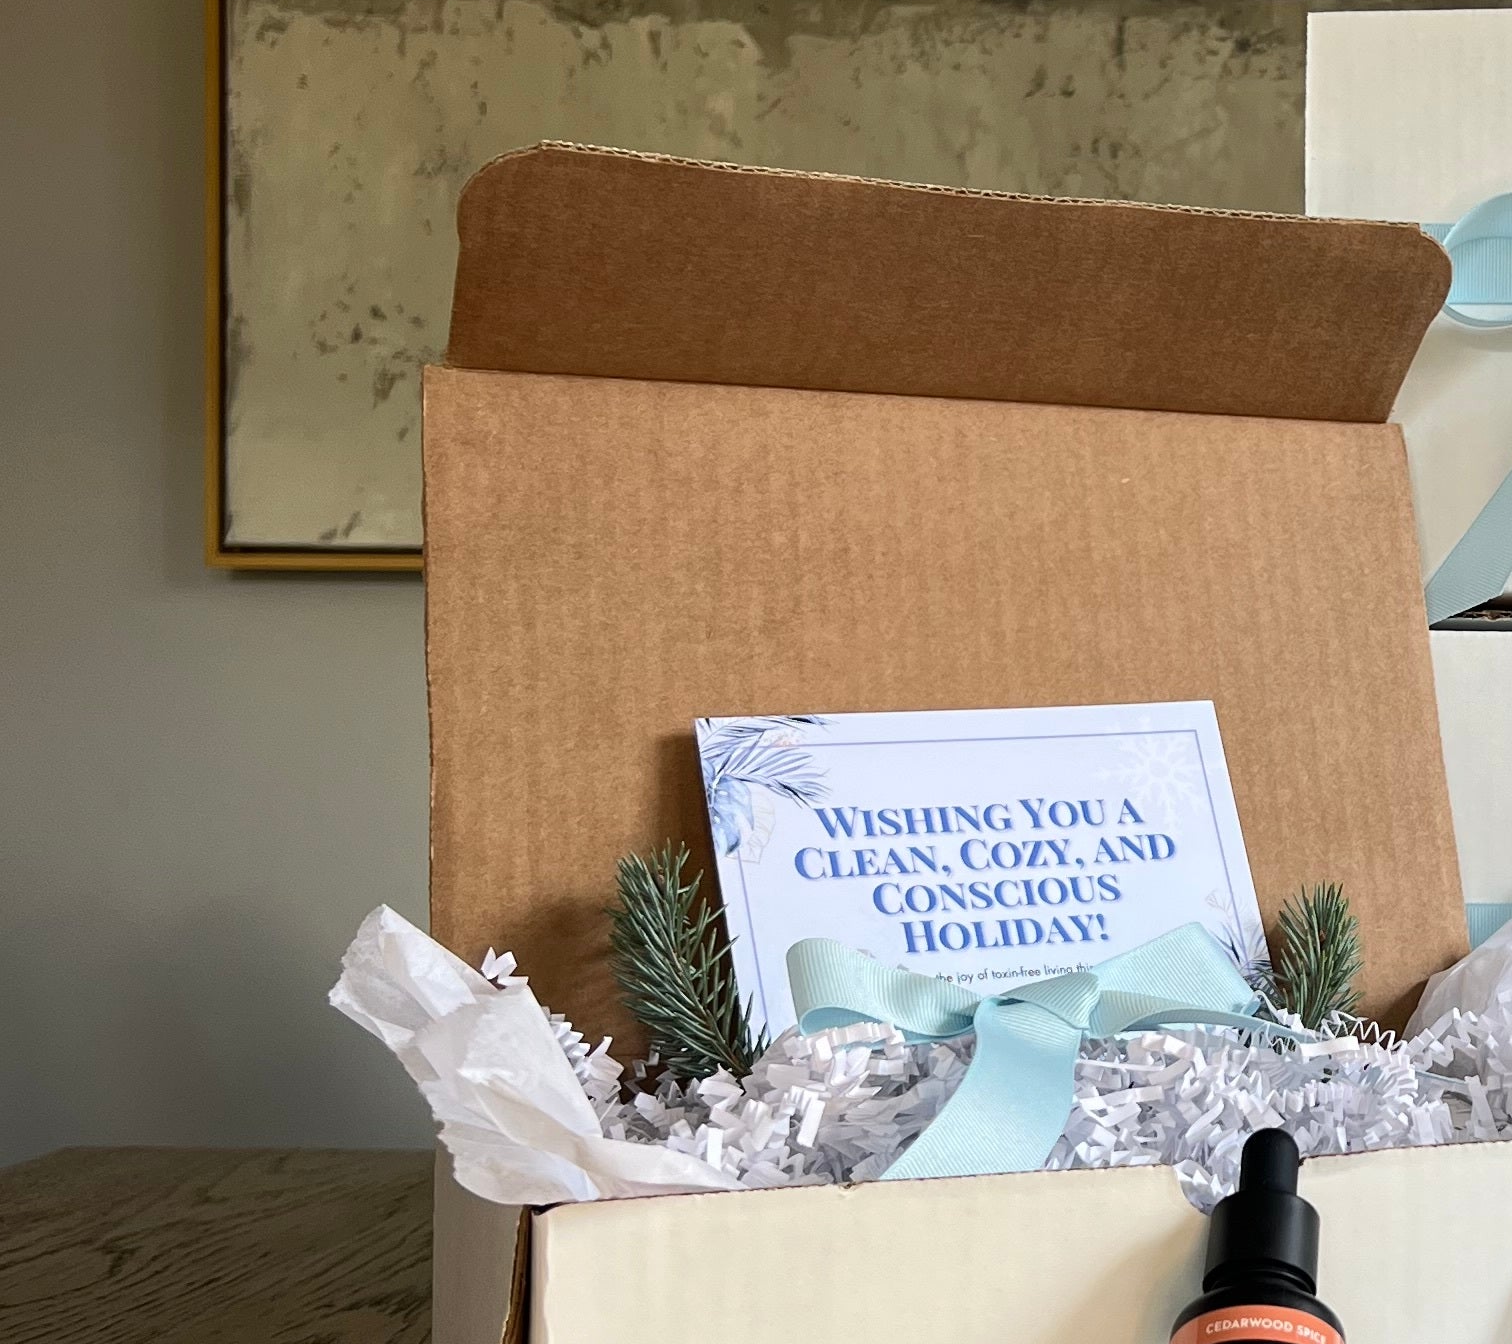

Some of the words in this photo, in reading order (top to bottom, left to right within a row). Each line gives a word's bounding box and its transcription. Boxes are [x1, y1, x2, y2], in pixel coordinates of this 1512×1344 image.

[813, 802, 1011, 838] WISHING
[1019, 798, 1106, 829] YOU
[1117, 798, 1144, 826] A
[794, 845, 951, 879] CLEAN,
[961, 837, 1085, 873] COZY,
[1094, 832, 1176, 863] AND
[873, 873, 1123, 915] CONSCIOUS
[900, 913, 1109, 953] HOLIDAY!
[957, 971, 974, 985] joy
[978, 968, 989, 980] of
[992, 965, 1041, 979] toxin-free
[1206, 1317, 1293, 1334] CEDARWOOD
